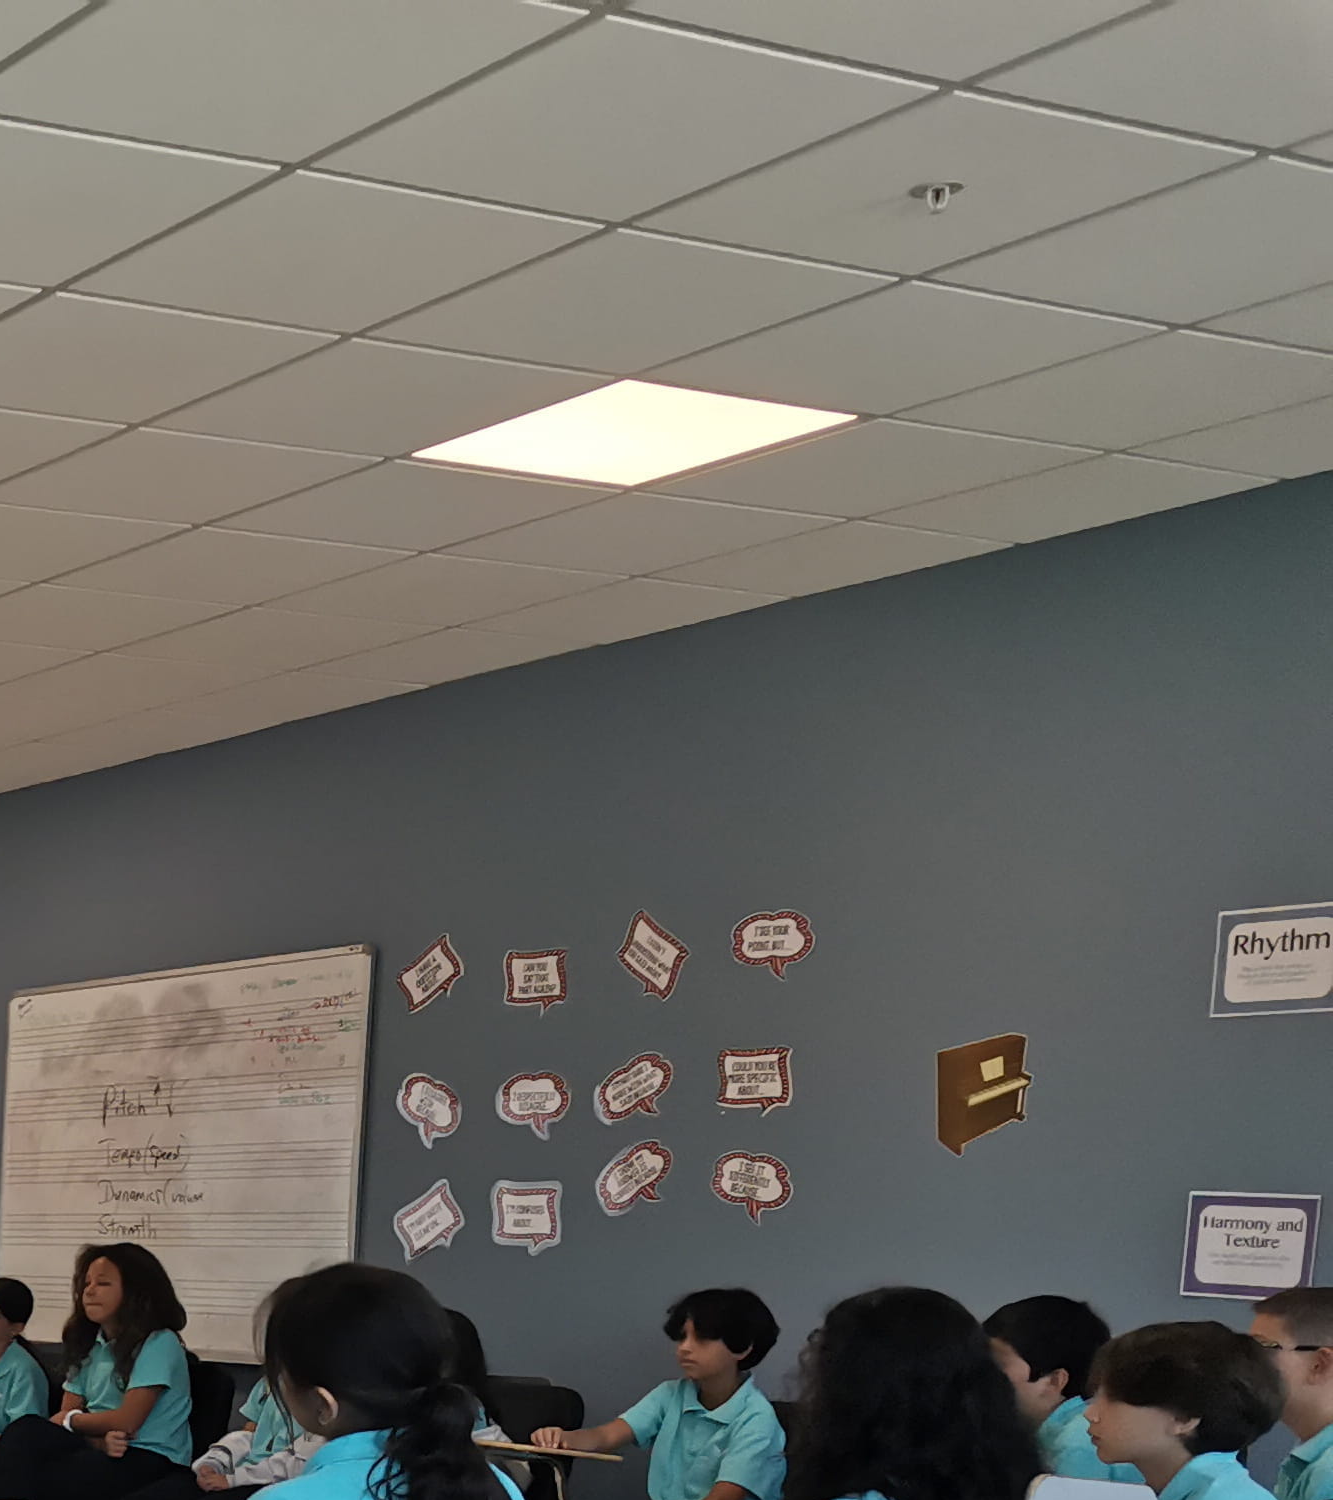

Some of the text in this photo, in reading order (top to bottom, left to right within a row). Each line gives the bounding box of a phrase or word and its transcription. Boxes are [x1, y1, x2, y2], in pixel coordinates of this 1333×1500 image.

[1233, 928, 1331, 960] Rhythm
[102, 1084, 148, 1128] Pitch
[1203, 1216, 1304, 1234] Harmony and
[1224, 1233, 1281, 1249] Texture
